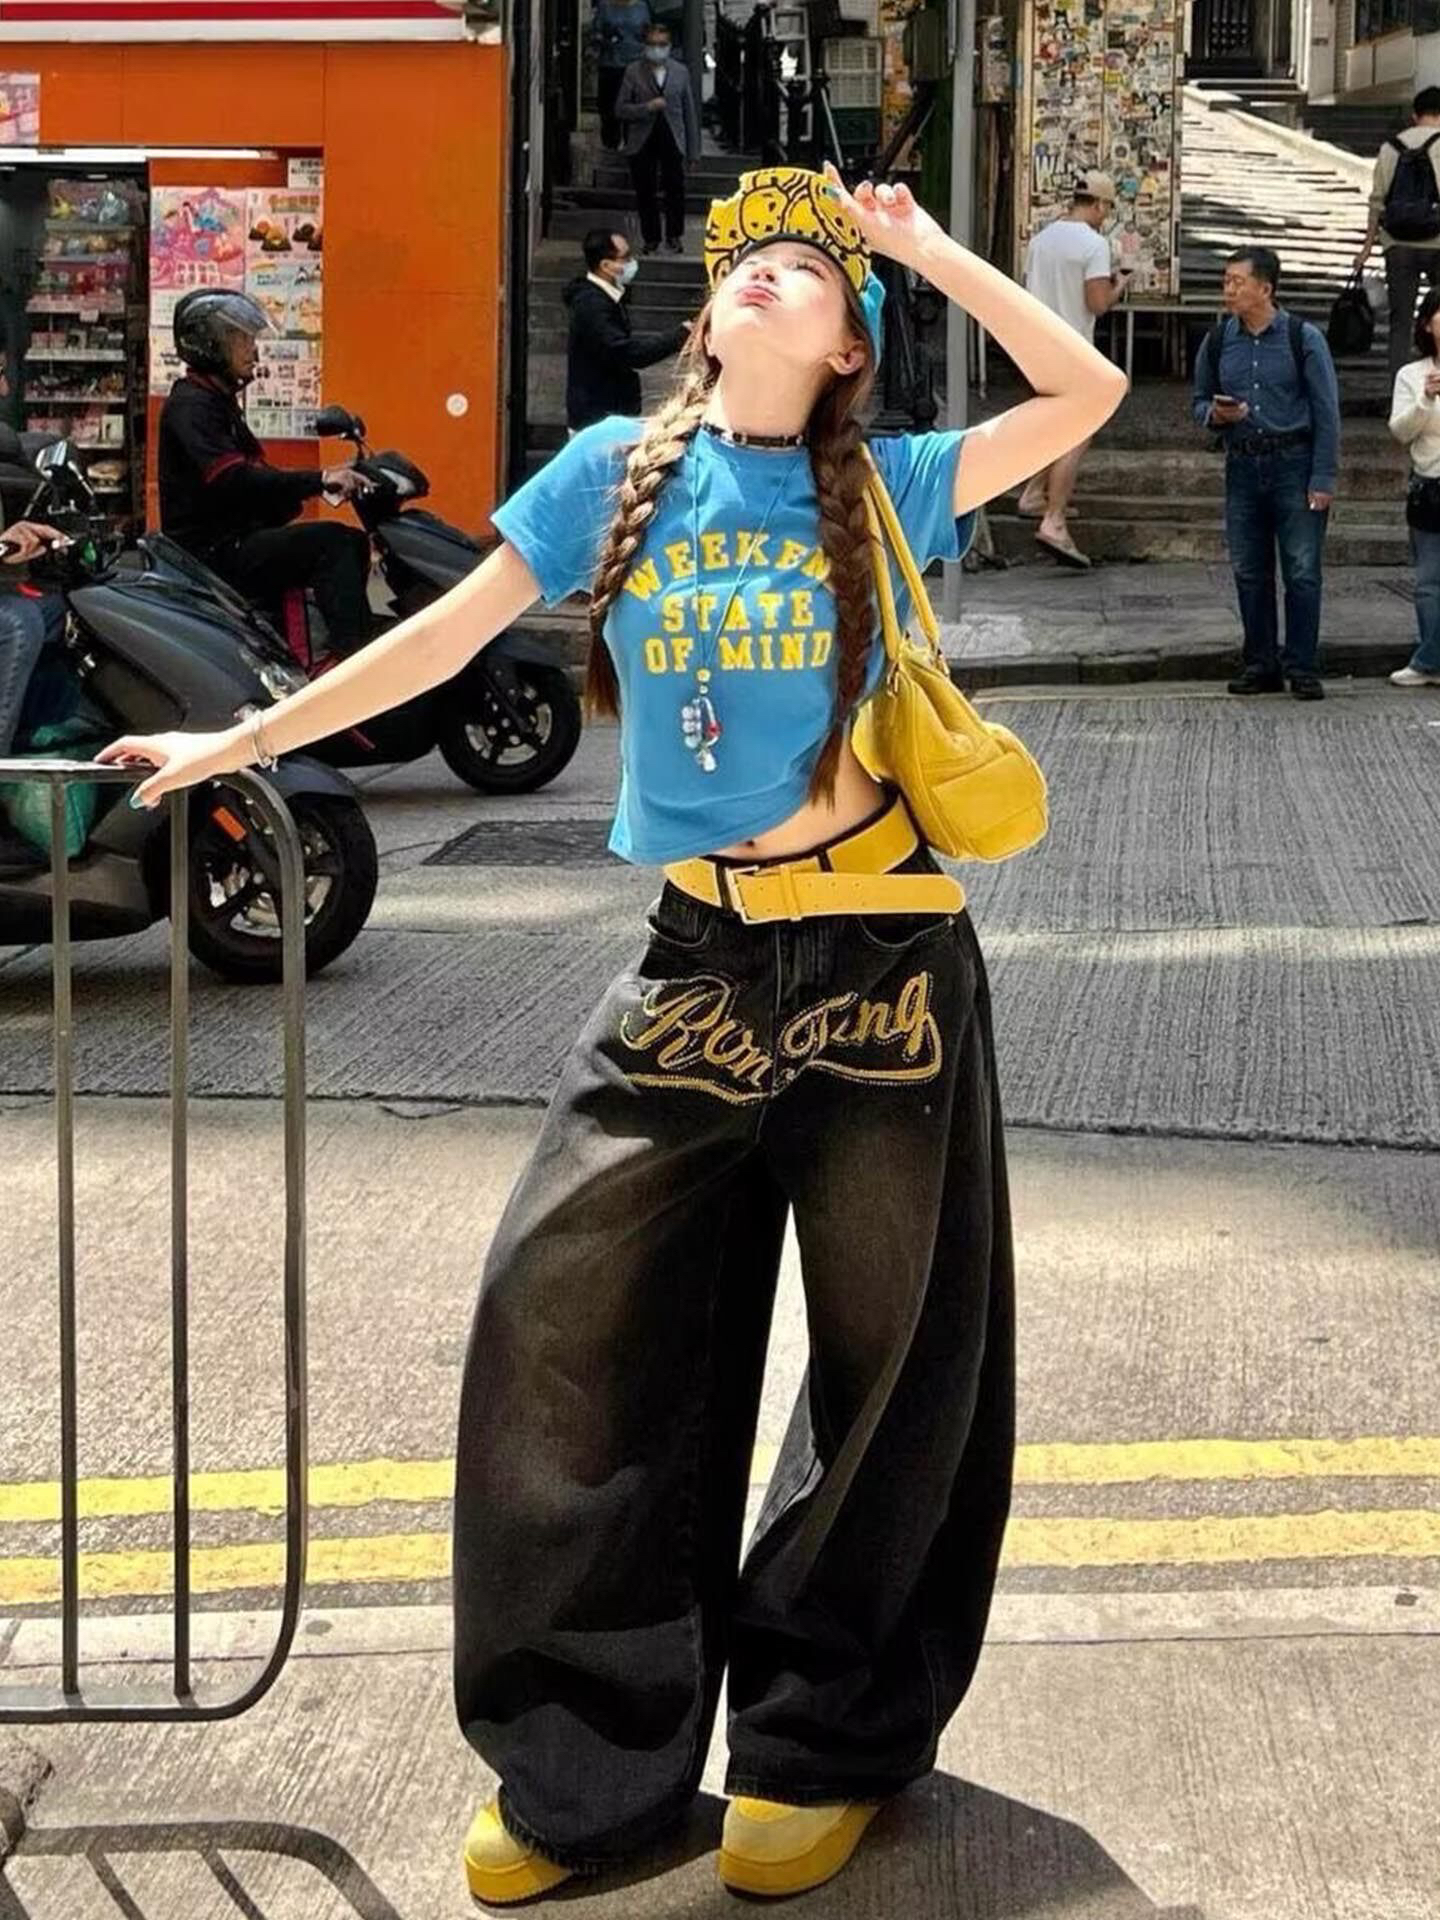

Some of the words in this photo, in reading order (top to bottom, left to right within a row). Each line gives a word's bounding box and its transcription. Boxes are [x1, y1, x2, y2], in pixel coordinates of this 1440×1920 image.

[624, 532, 832, 601] WEEKEN
[661, 590, 815, 633] STATE
[645, 636, 694, 674] OF
[718, 631, 832, 671] MIND
